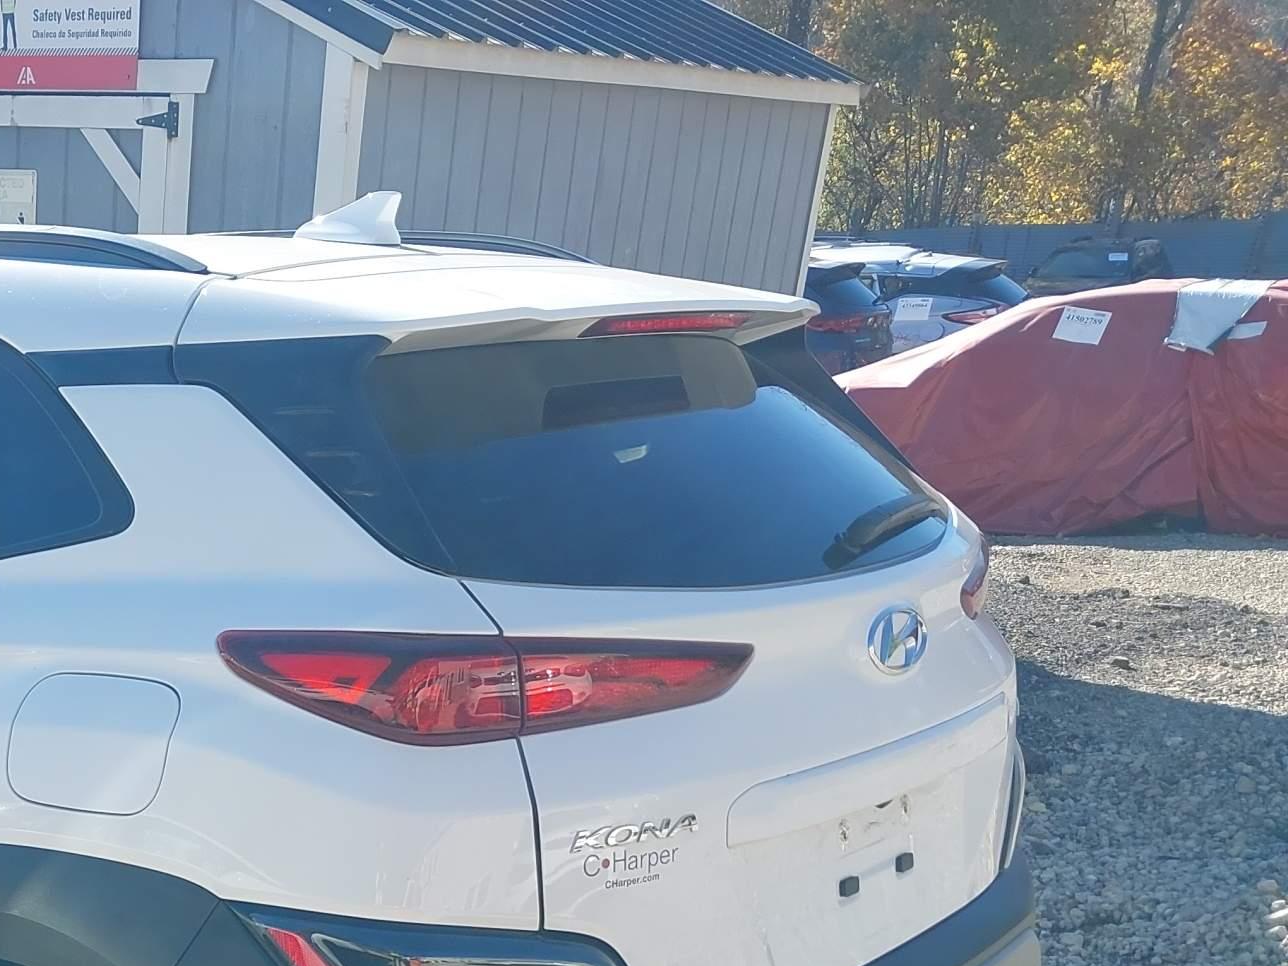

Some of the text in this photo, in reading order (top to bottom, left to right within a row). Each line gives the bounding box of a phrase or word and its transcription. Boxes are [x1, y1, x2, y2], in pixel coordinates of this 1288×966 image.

[33, 7, 132, 24] Safety Vest Required
[32, 29, 57, 38] Chaleco
[58, 29, 66, 38] de
[67, 29, 99, 39] Seguridad
[569, 813, 698, 853] KONA
[605, 873, 660, 889] CHarper.com
